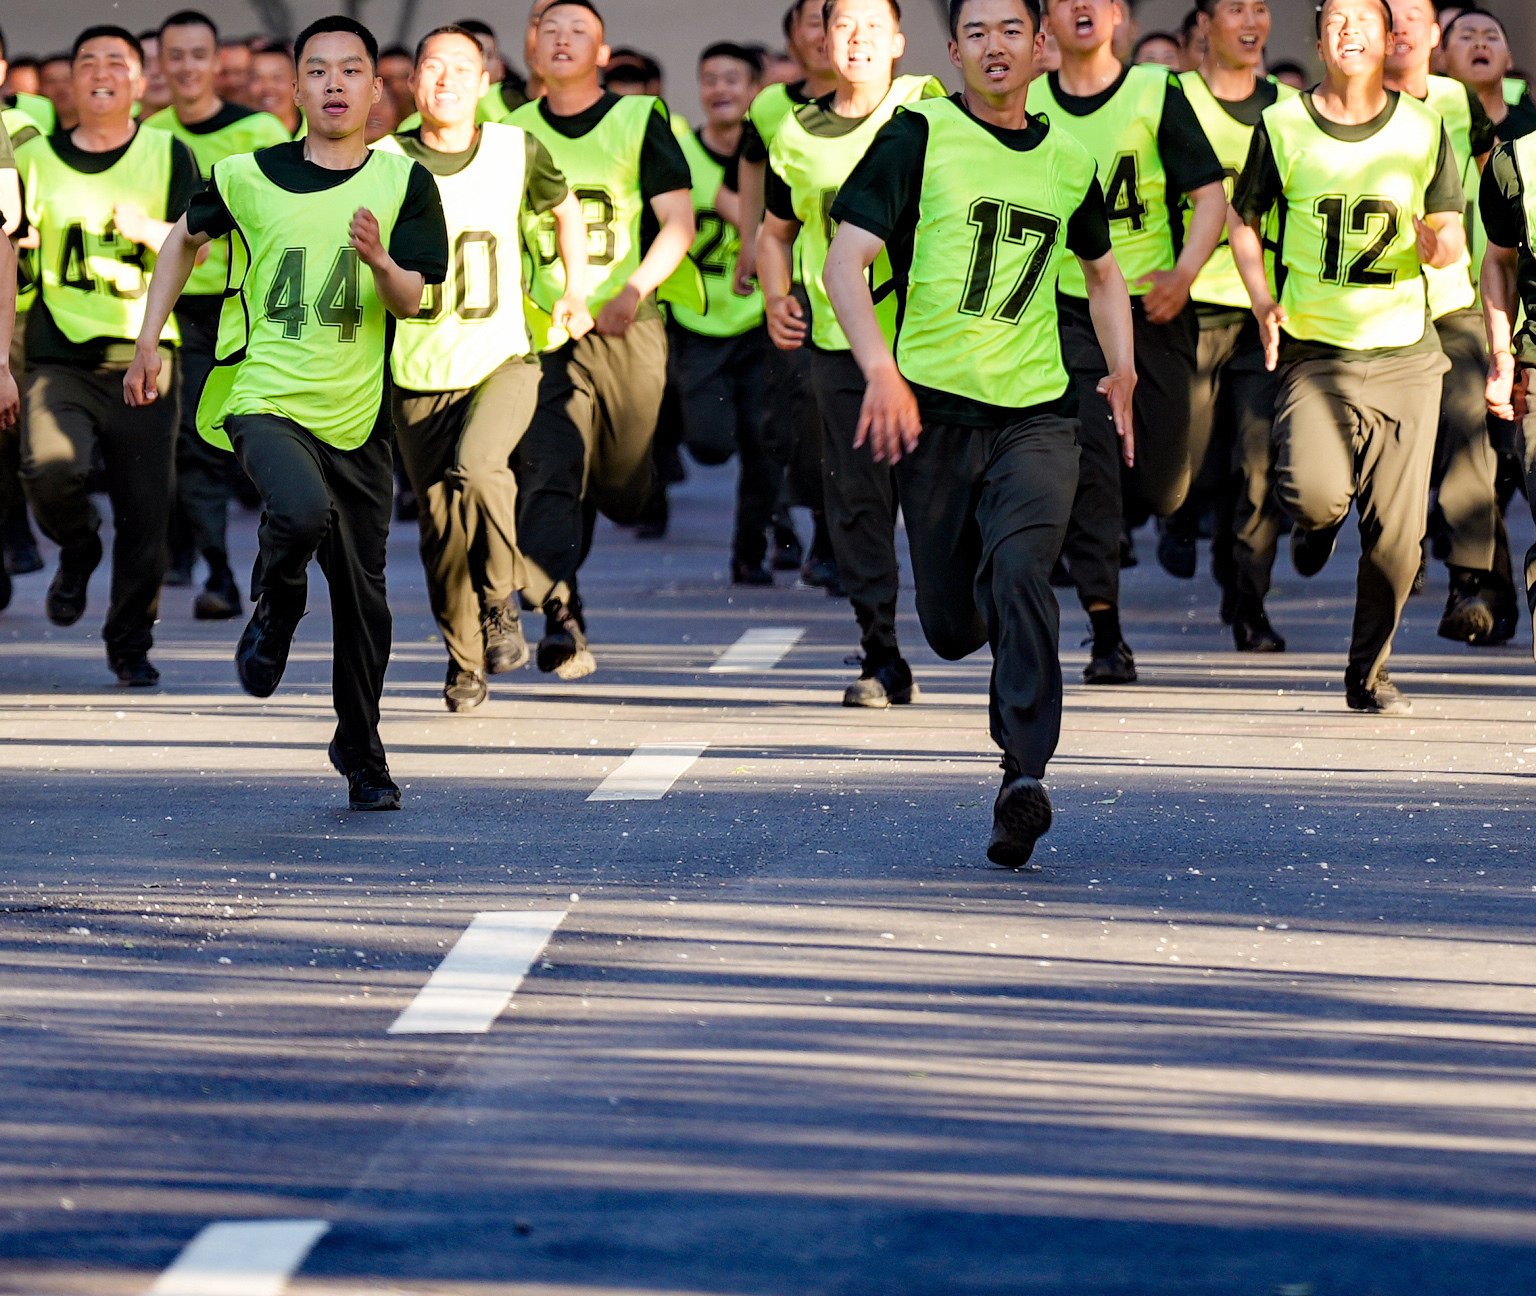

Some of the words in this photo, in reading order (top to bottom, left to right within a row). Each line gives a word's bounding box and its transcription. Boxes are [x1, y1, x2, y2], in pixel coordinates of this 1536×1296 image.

[59, 217, 147, 299] 43
[406, 226, 501, 324] 0
[958, 196, 1061, 325] 17
[1313, 194, 1402, 289] 12
[264, 247, 363, 342] 44
